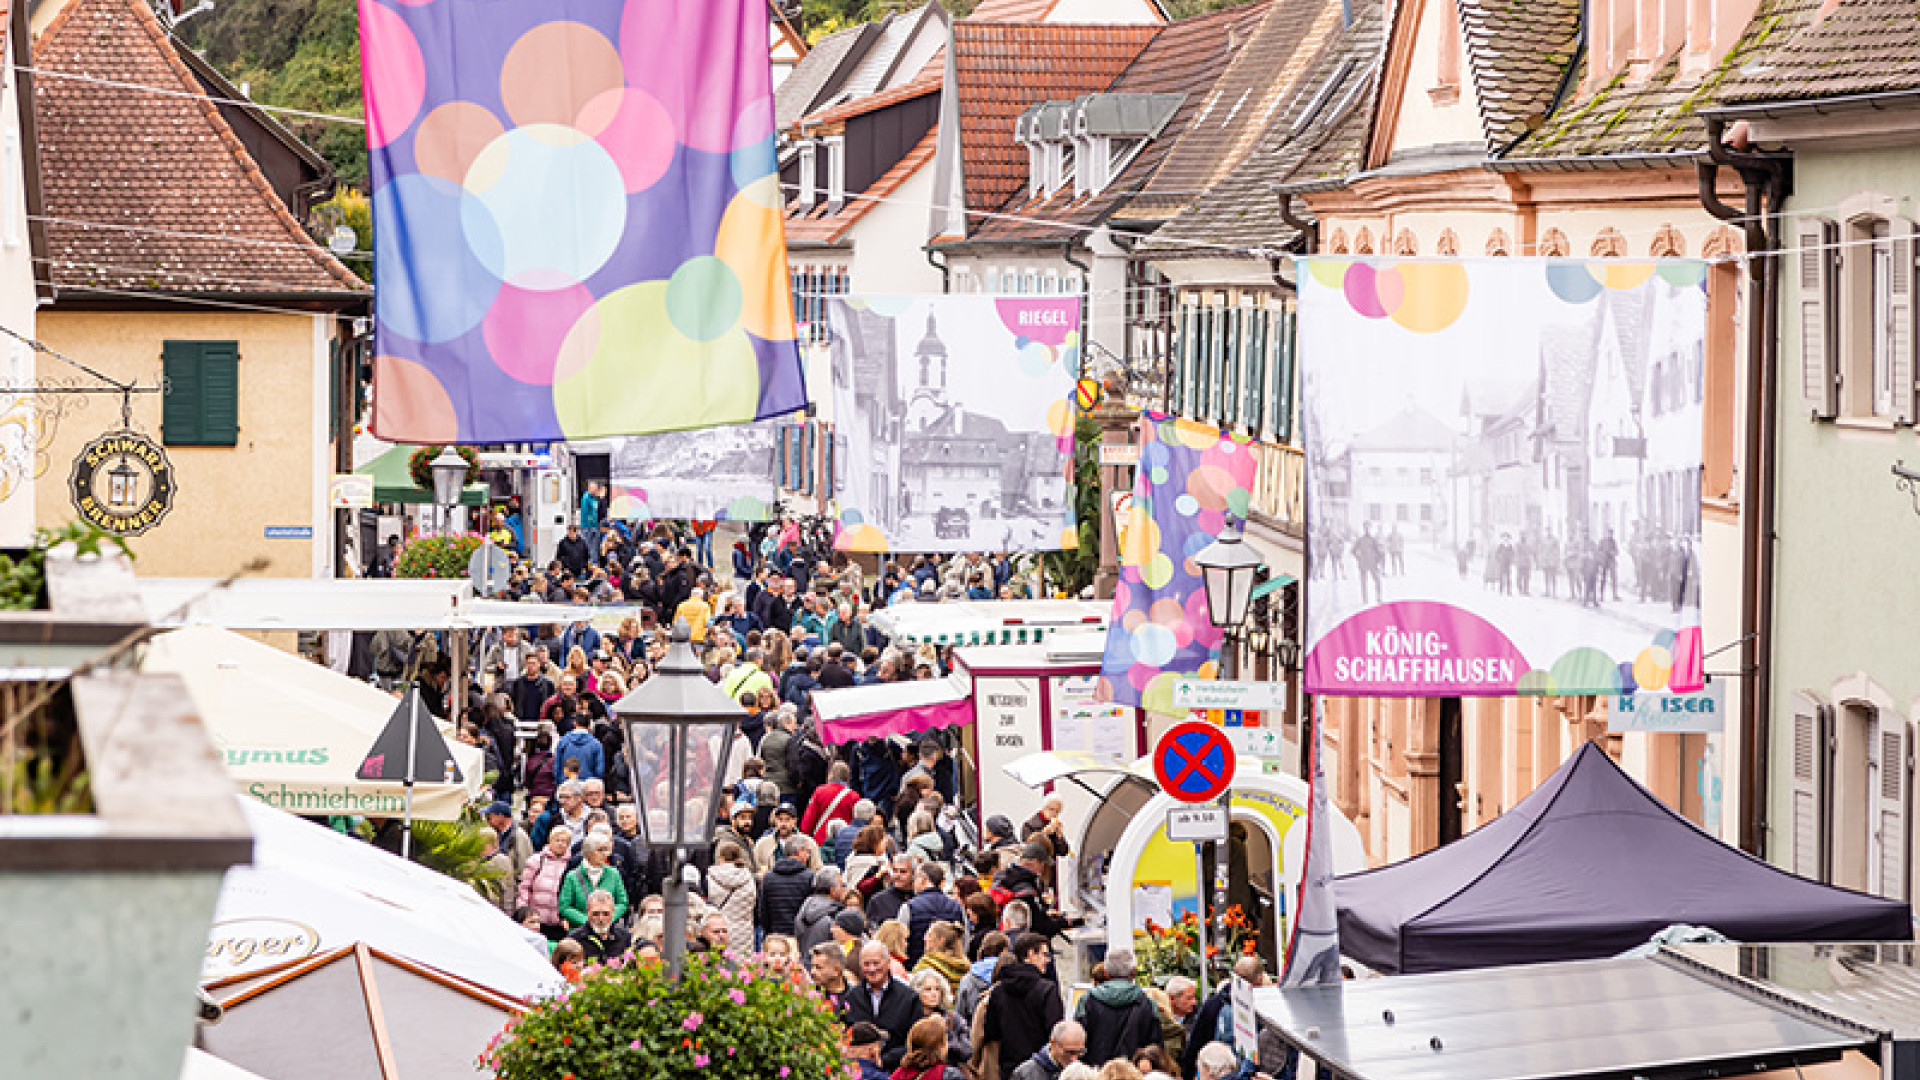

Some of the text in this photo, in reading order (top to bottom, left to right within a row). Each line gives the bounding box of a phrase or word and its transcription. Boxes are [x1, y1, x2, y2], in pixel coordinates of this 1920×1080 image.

[1019, 310, 1069, 326] RIEGEL
[80, 496, 163, 531] BRENNER
[1365, 626, 1449, 656] KÖNIG-
[1335, 656, 1516, 685] SCHAFFHAUSEN
[248, 782, 408, 813] Schmieheim
